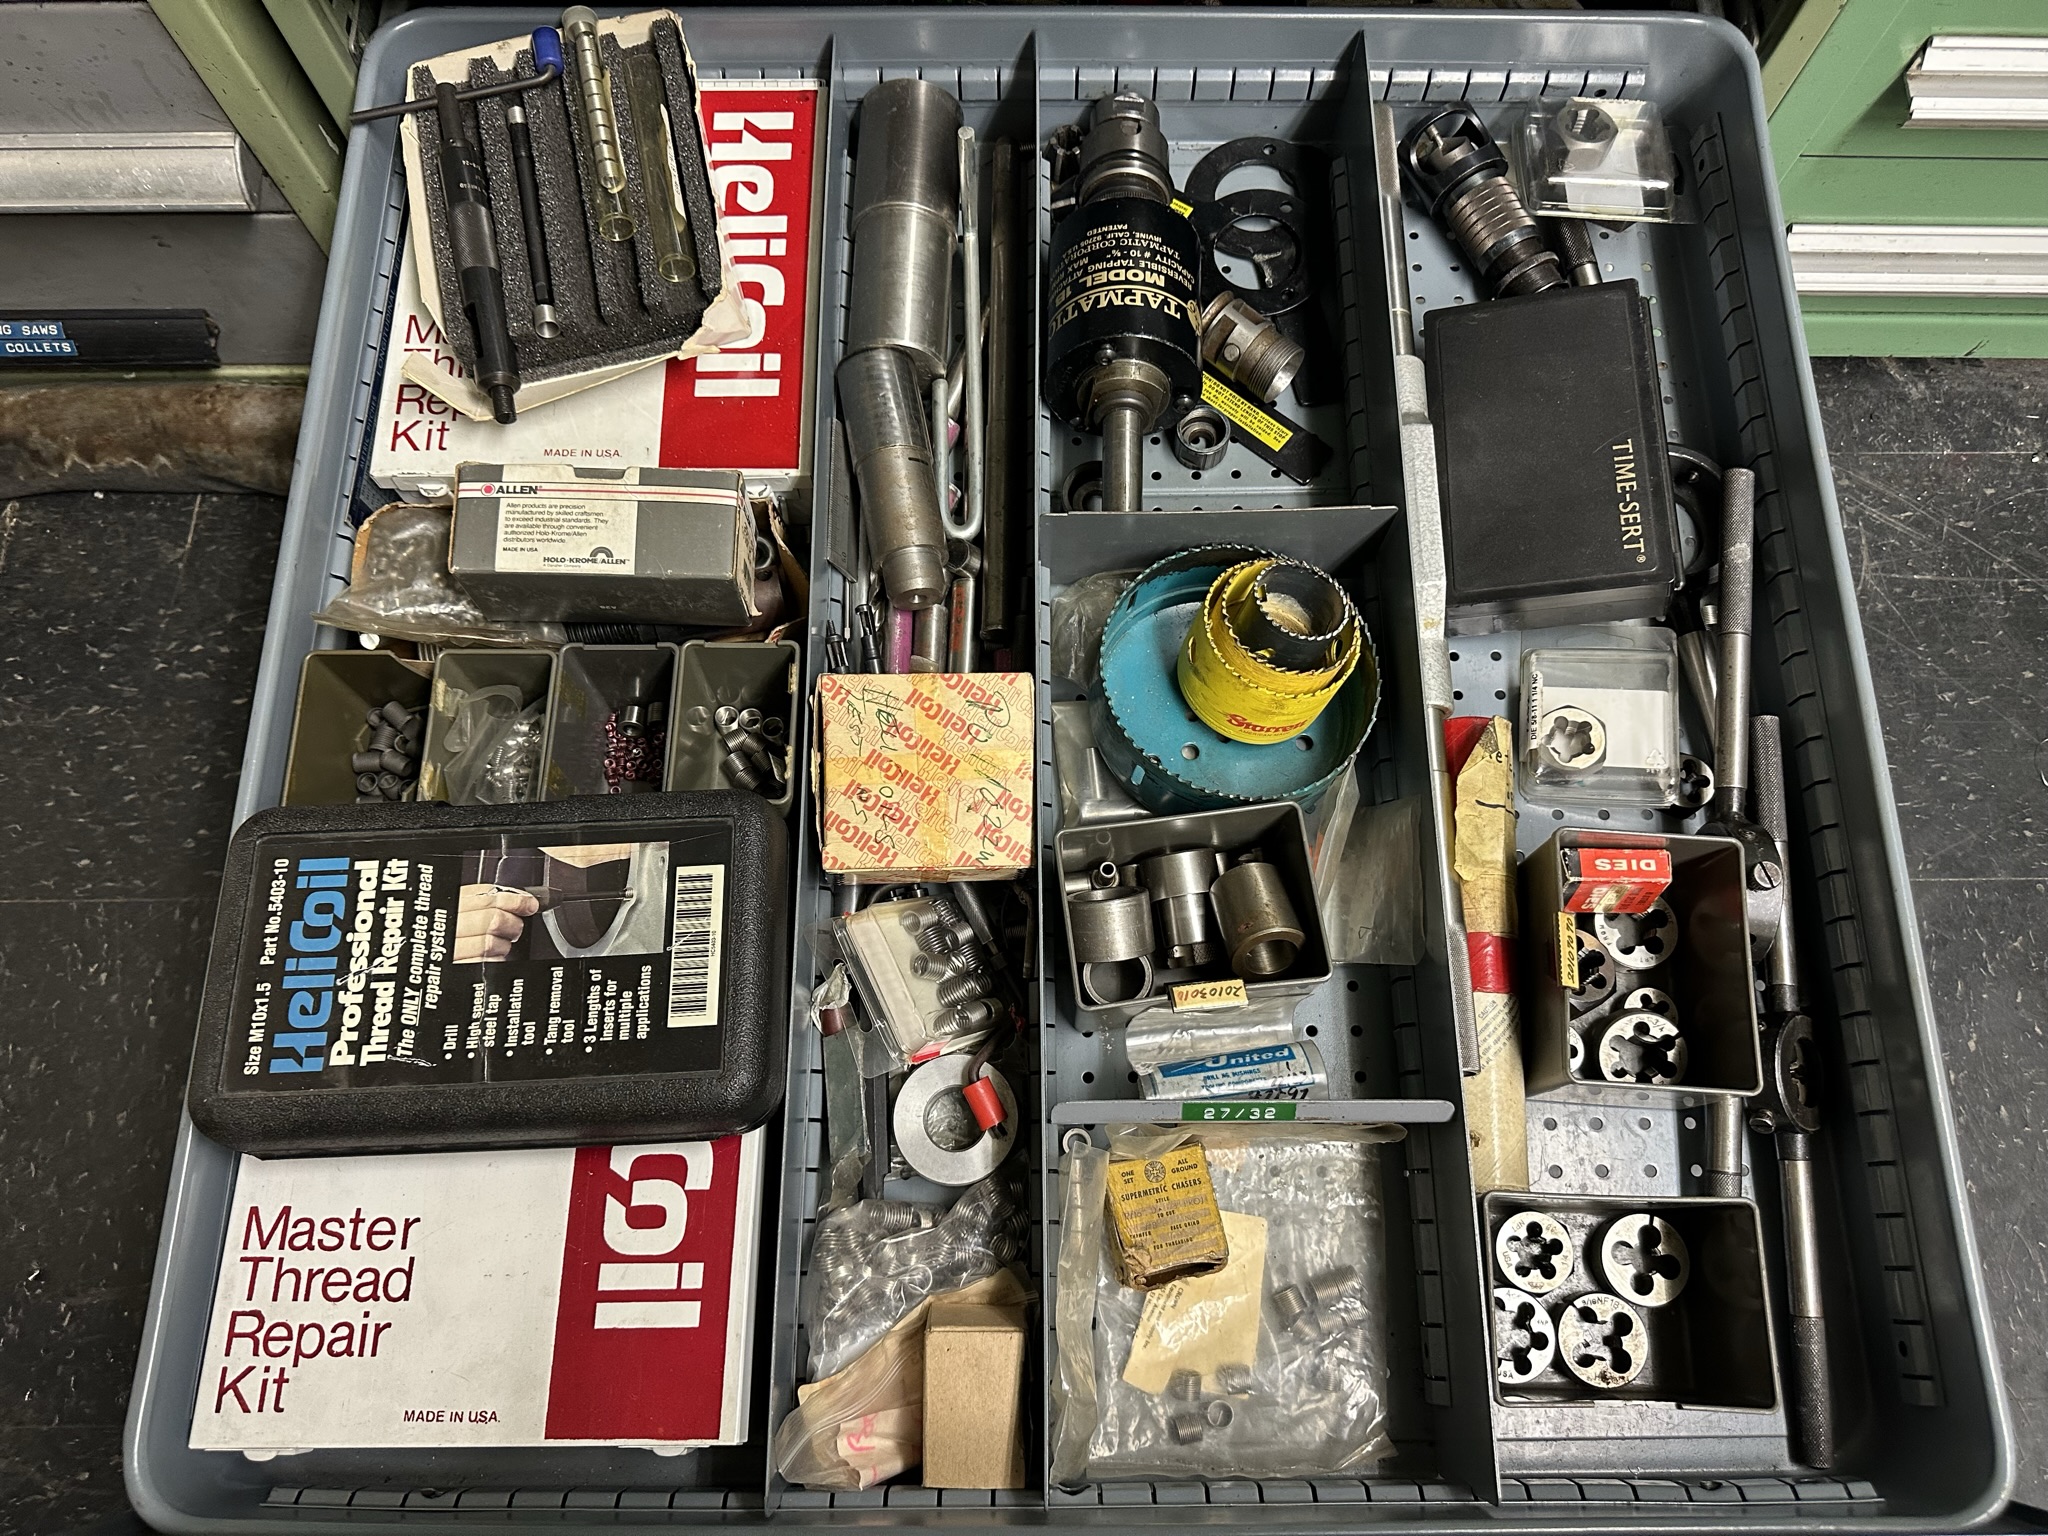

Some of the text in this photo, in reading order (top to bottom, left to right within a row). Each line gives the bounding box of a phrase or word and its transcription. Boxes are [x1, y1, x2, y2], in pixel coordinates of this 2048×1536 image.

[1086, 223, 1128, 237] PATENTED
[1104, 231, 1130, 240] CALIF.
[1133, 231, 1162, 243] IRVINE,
[1120, 238, 1181, 260] TAPMATIC
[1067, 256, 1089, 274] MAX
[1087, 258, 1135, 273] TAPPING
[1139, 259, 1193, 291] REVERSIBLE
[1155, 253, 1195, 285] CAPACITY
[1078, 268, 1165, 288] MODEL
[1050, 289, 1181, 340] TAPMATIC
[22, 325, 58, 336] SAWS
[5, 342, 72, 353] COLLETS
[390, 419, 450, 452] Kit
[543, 449, 577, 457] MADE
[580, 449, 592, 457] IN
[495, 485, 538, 495] ALLEN
[1611, 438, 1644, 552] TIME-SERT
[505, 509, 548, 517] manufactured
[522, 503, 547, 511] products
[559, 503, 585, 511] precision
[542, 523, 565, 531] through
[594, 517, 609, 526] They
[1531, 673, 1538, 685] NC
[1594, 858, 1657, 871] DIES
[243, 858, 290, 1077] Size M10x1.5 Part No.5403-10
[269, 857, 350, 1074] HeliCoil
[328, 859, 380, 1067] Professional
[359, 858, 410, 1067] Thread Repair Kit
[395, 863, 434, 1057] The ONLY complete thread
[423, 908, 448, 1010] repair system
[504, 978, 524, 1048] Installation
[543, 966, 564, 1046] Tang removal
[583, 968, 603, 1044] 3 Lengths of
[600, 979, 618, 1042] inserts for
[636, 964, 653, 1040] applications
[465, 982, 485, 1049] High speed
[483, 993, 502, 1048] steel tap
[618, 990, 636, 1041] multiple
[443, 1024, 459, 1050] Drill
[521, 1020, 536, 1046] tool
[560, 1019, 576, 1044] tool
[1204, 1047, 1290, 1068] United
[1203, 1107, 1276, 1120] 27/32
[1121, 1169, 1135, 1178] ONE
[1123, 1177, 1134, 1185] SET
[1171, 1163, 1198, 1174] GROUND
[1121, 1177, 1202, 1202] SUPERMETRIC CHASERS
[242, 1205, 421, 1252] Master
[239, 1256, 416, 1303] Thread
[224, 1310, 392, 1368] Repair
[214, 1366, 290, 1414] Kit
[403, 1409, 445, 1424] MADE
[449, 1409, 464, 1424] IN
